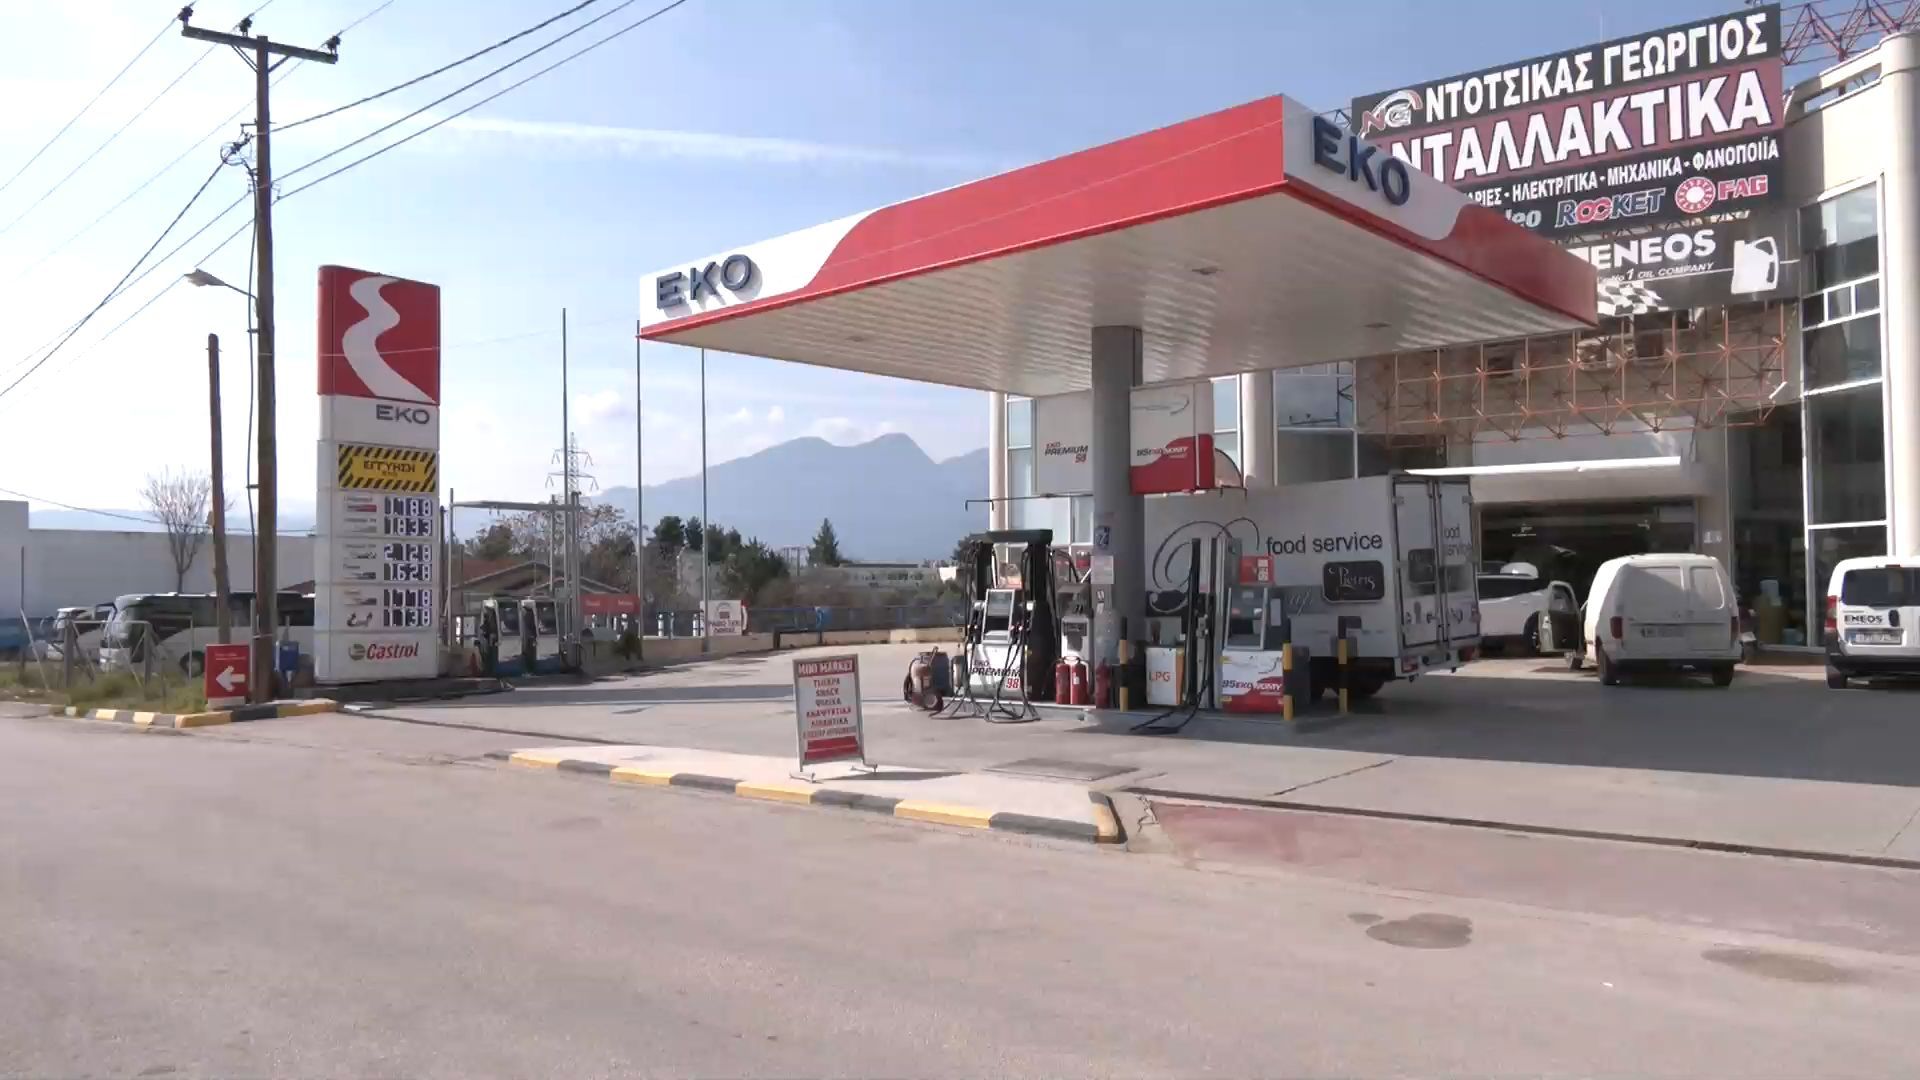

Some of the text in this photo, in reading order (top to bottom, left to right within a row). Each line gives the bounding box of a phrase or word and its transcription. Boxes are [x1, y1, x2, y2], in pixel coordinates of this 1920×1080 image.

[1425, 13, 1767, 123] ΝΤΟΤΣΙΚΑΣ ΓΕΩΡΓΙΟΣ
[1391, 70, 1772, 182] ΝΤΑΛΛΑΚΤΙΚΑ
[1313, 115, 1410, 206] EKO
[1607, 156, 1682, 187] ΜΗΧΑΝΙΚΑ
[1717, 175, 1768, 200] FAG
[1554, 187, 1666, 228] ROCKET
[656, 253, 752, 310] EKO
[1658, 262, 1714, 278] COMPANY
[376, 404, 430, 425] EKO
[1265, 531, 1383, 556] food service
[1844, 615, 1883, 624] ENEOS
[367, 641, 419, 660] Castrol
[1006, 677, 1020, 689] 98
